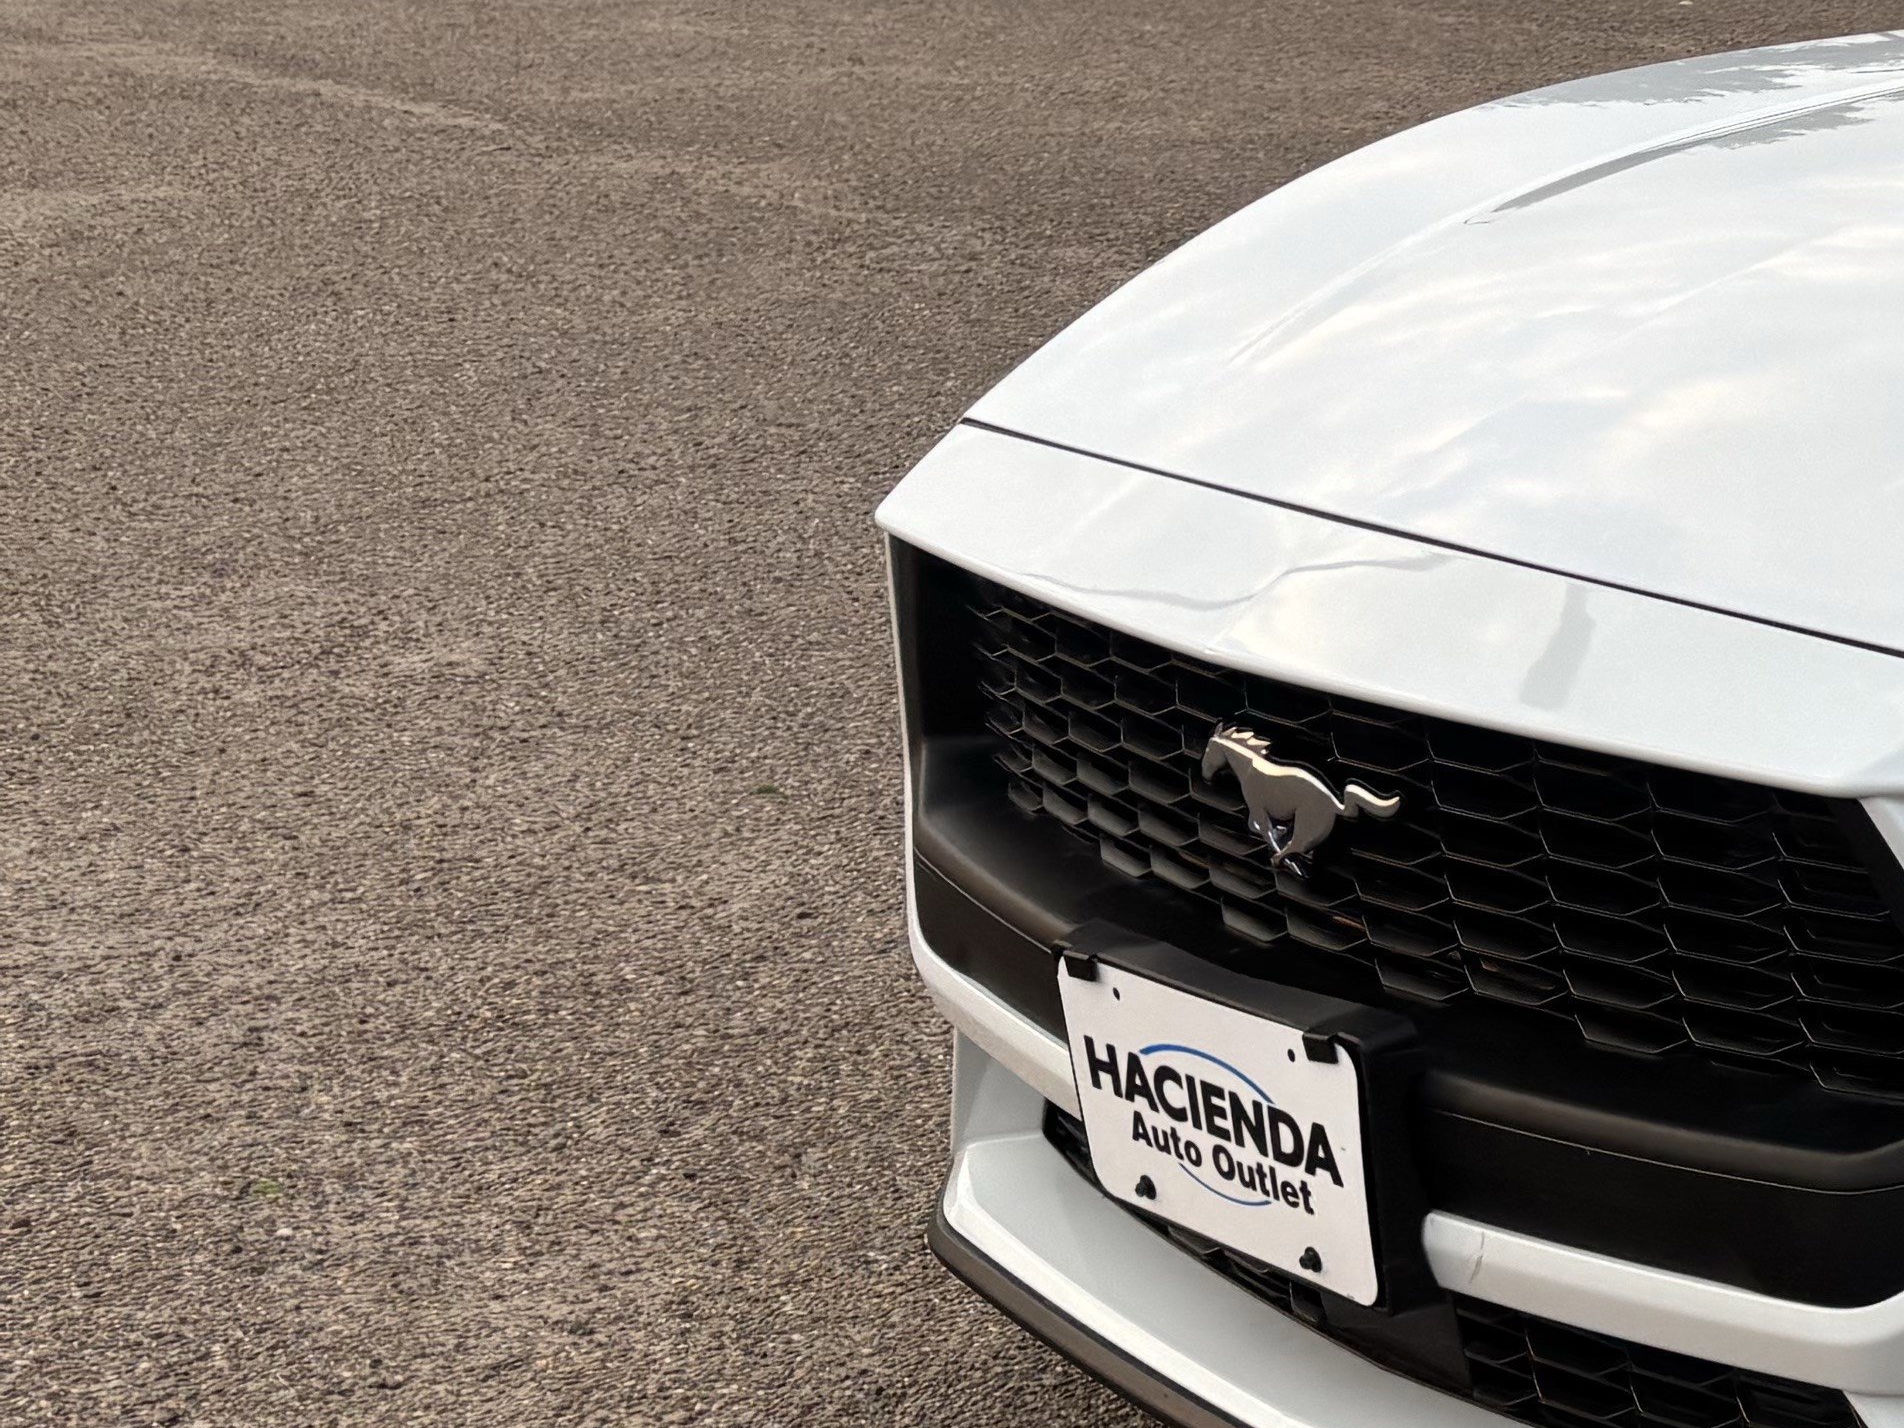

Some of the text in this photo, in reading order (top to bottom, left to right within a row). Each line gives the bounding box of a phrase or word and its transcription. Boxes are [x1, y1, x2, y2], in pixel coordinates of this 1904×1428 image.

[1083, 1035, 1344, 1188] HACIENDA
[1132, 1110, 1316, 1216] Auto Outlet
